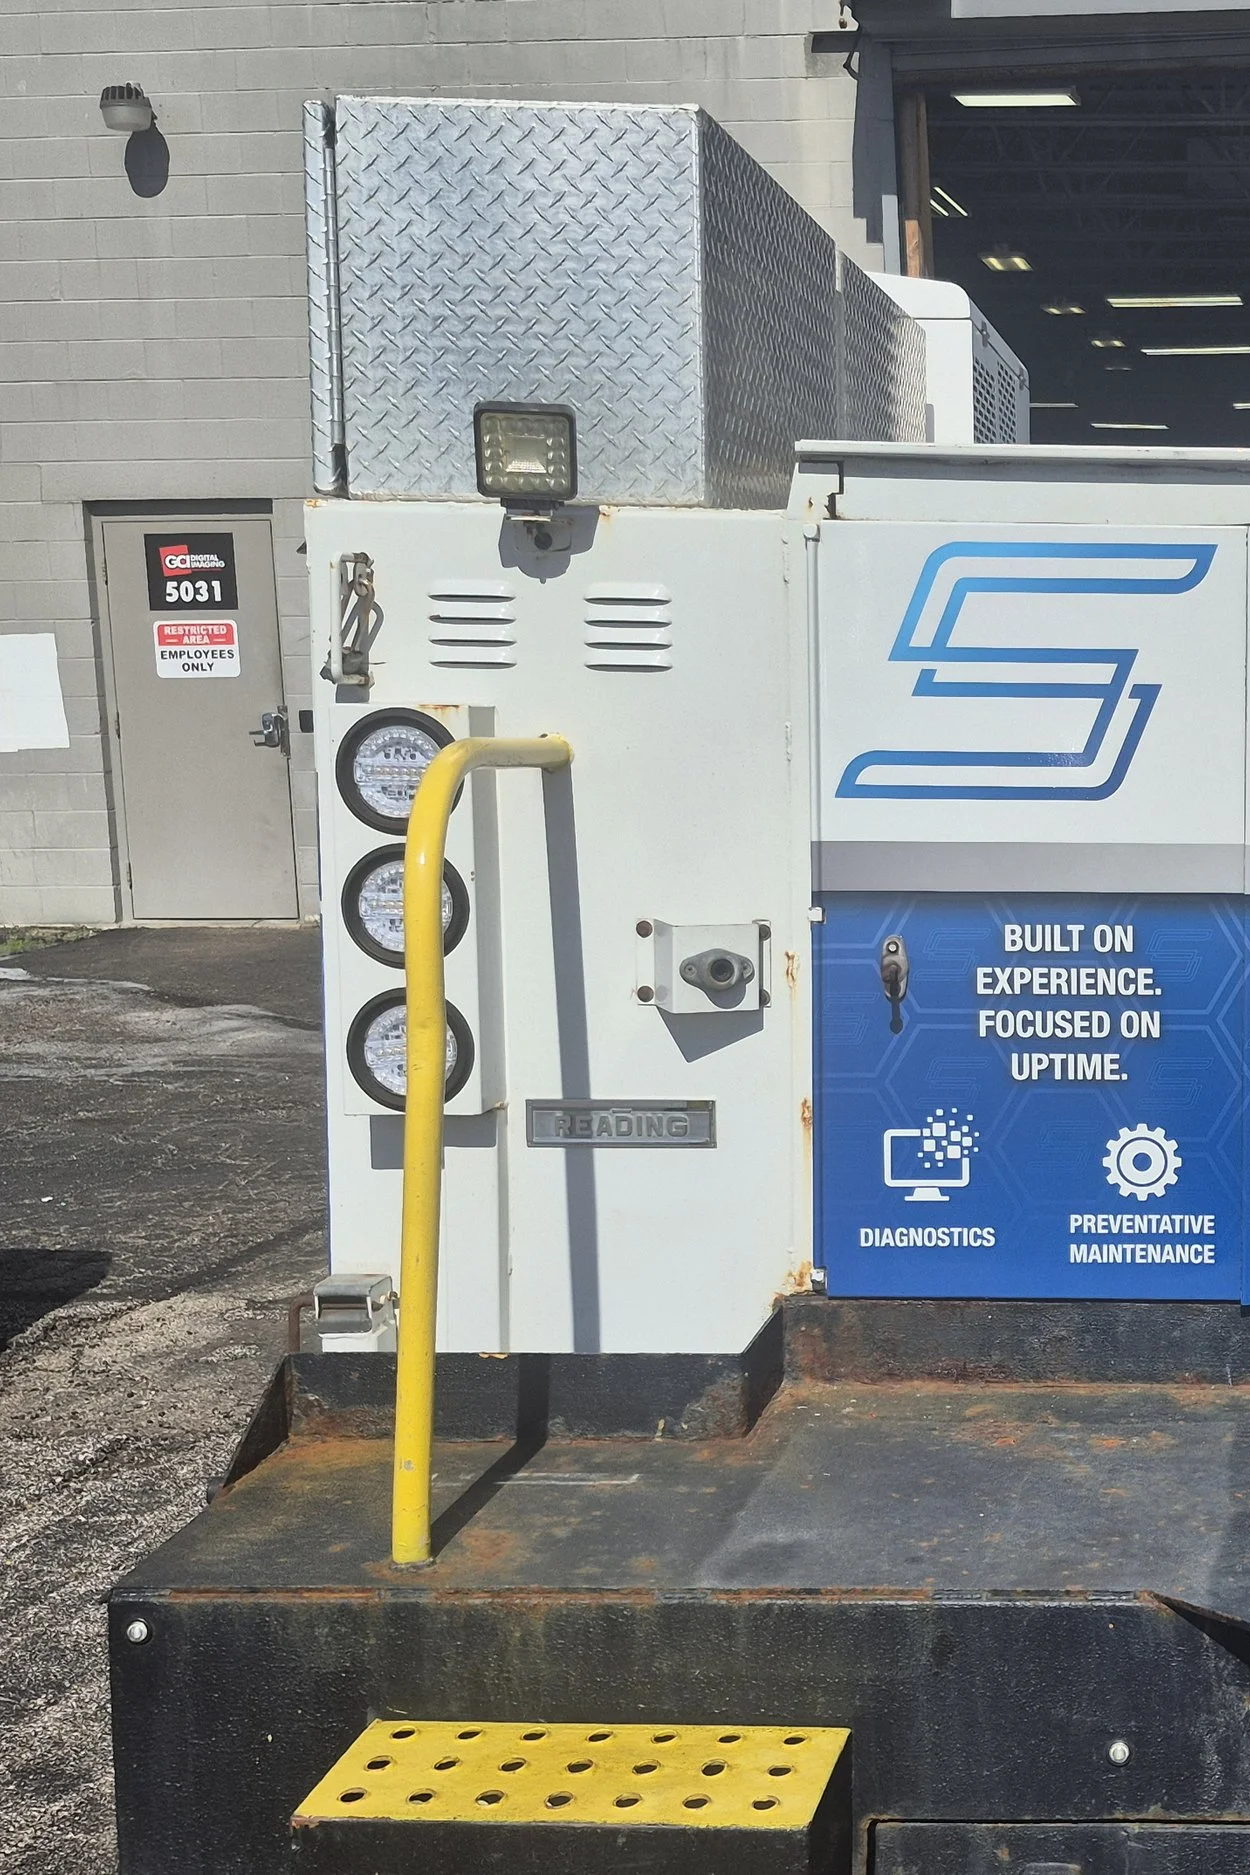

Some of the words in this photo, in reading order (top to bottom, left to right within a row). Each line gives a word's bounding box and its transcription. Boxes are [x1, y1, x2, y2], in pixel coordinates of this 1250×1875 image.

[190, 554, 219, 562] DIGITAL
[190, 561, 226, 569] IMAGING
[165, 580, 222, 602] 5031
[164, 625, 227, 635] RESTRICTED
[182, 635, 211, 645] AREA
[160, 649, 235, 660] EMPLOYEES
[182, 662, 214, 672] ONLY
[1004, 924, 1085, 953] BUILT
[1093, 924, 1134, 954] ON
[976, 967, 1162, 996] EXPERIENCE.
[978, 1009, 1111, 1039] FOCUSED
[1120, 1010, 1161, 1039] ON
[1011, 1052, 1128, 1082] UPTIME.
[554, 1114, 689, 1138] READING
[1069, 1214, 1216, 1235] PREVENTATIVE
[859, 1227, 996, 1248] DIAGNOSTICS
[1069, 1243, 1216, 1264] MAINTENANCE
